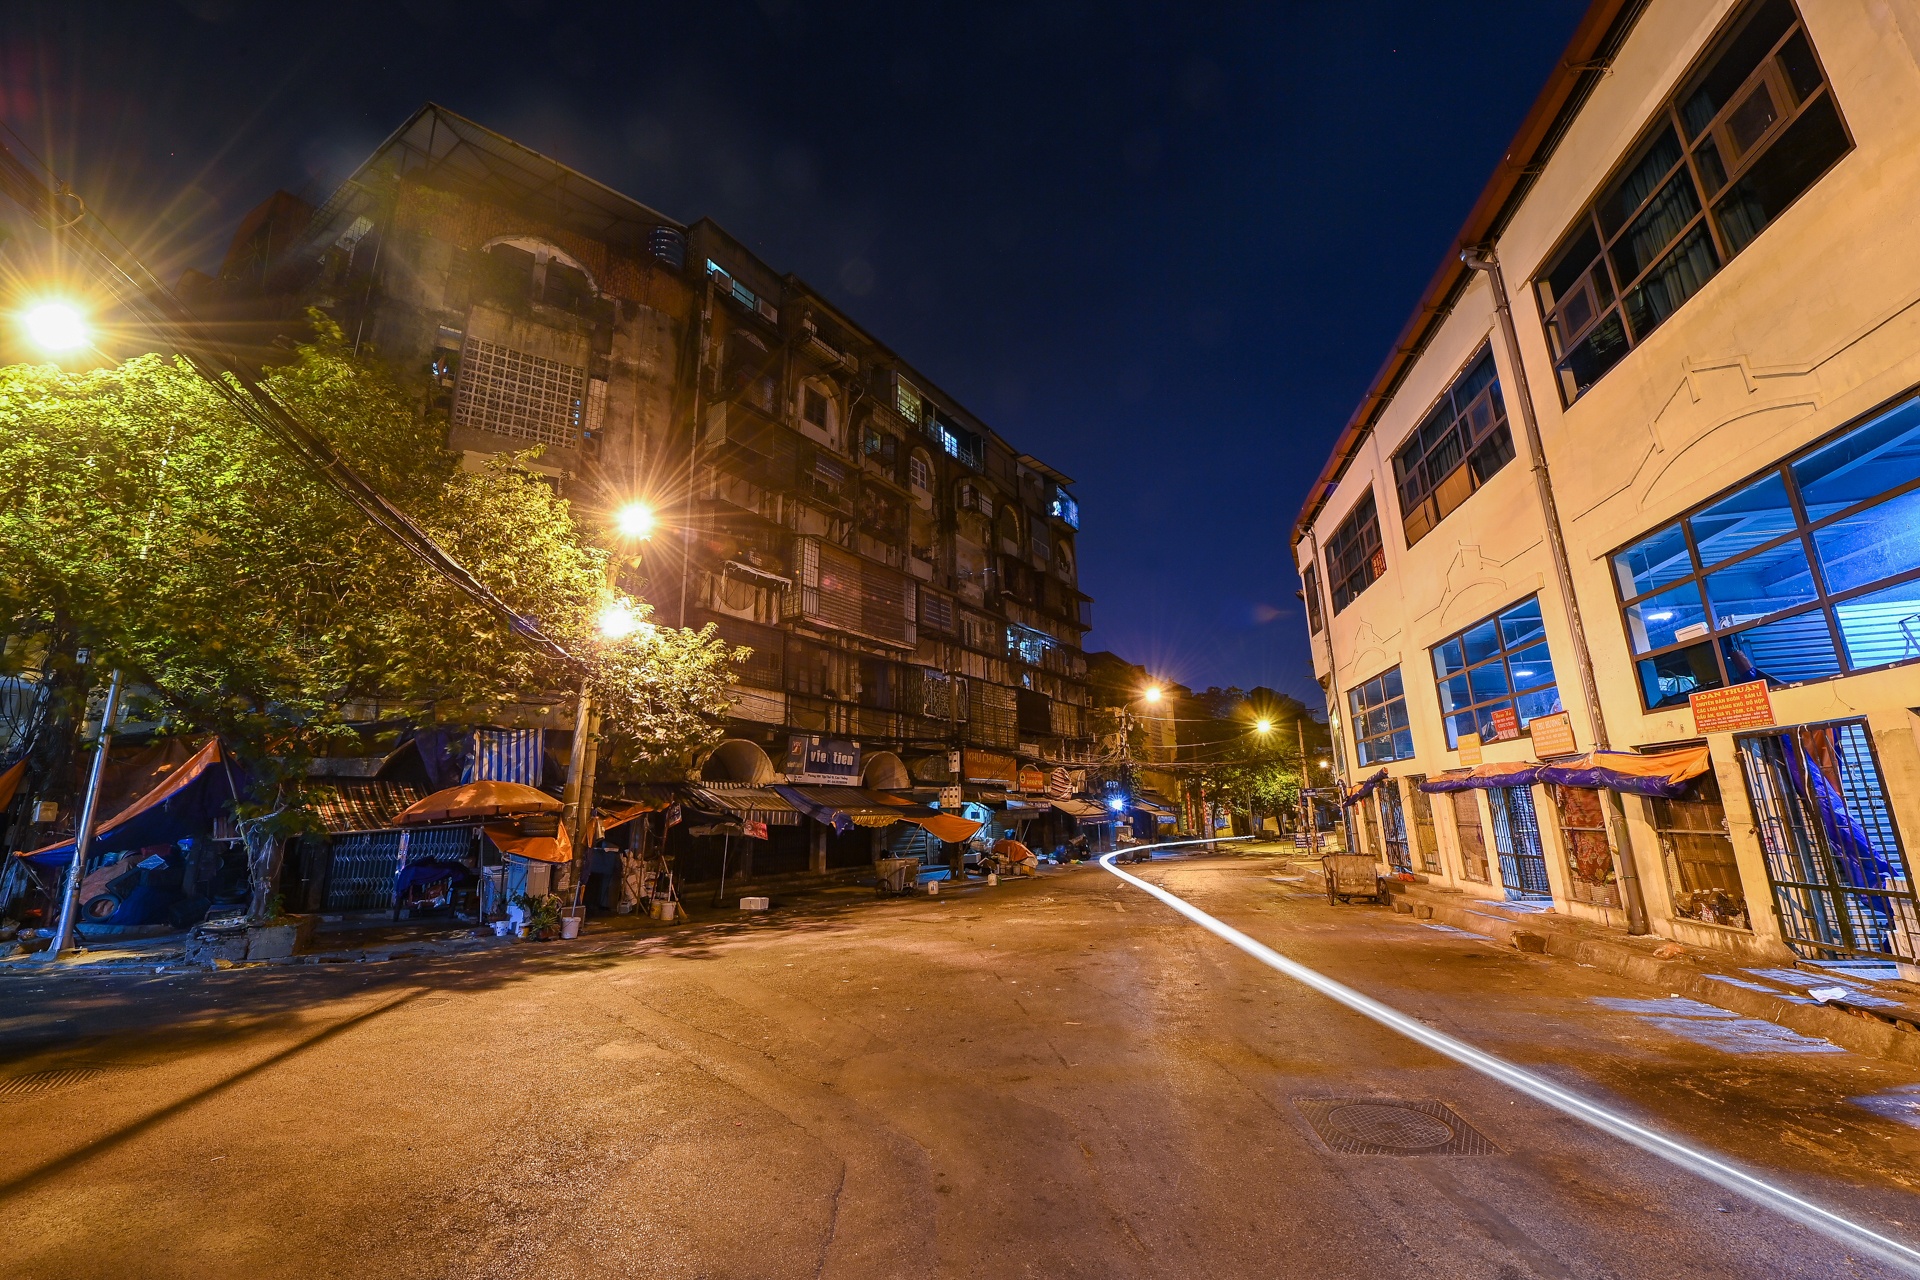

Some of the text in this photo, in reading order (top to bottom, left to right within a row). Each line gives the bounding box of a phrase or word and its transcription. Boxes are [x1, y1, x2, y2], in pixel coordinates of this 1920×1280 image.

[1695, 684, 1760, 701] LOAN THUẬN
[1696, 699, 1714, 707] CHUYÊN
[1715, 697, 1725, 705] BÁN
[1726, 695, 1740, 703] BUÔN
[1719, 703, 1732, 711] HÀNG
[967, 752, 980, 762] KHU
